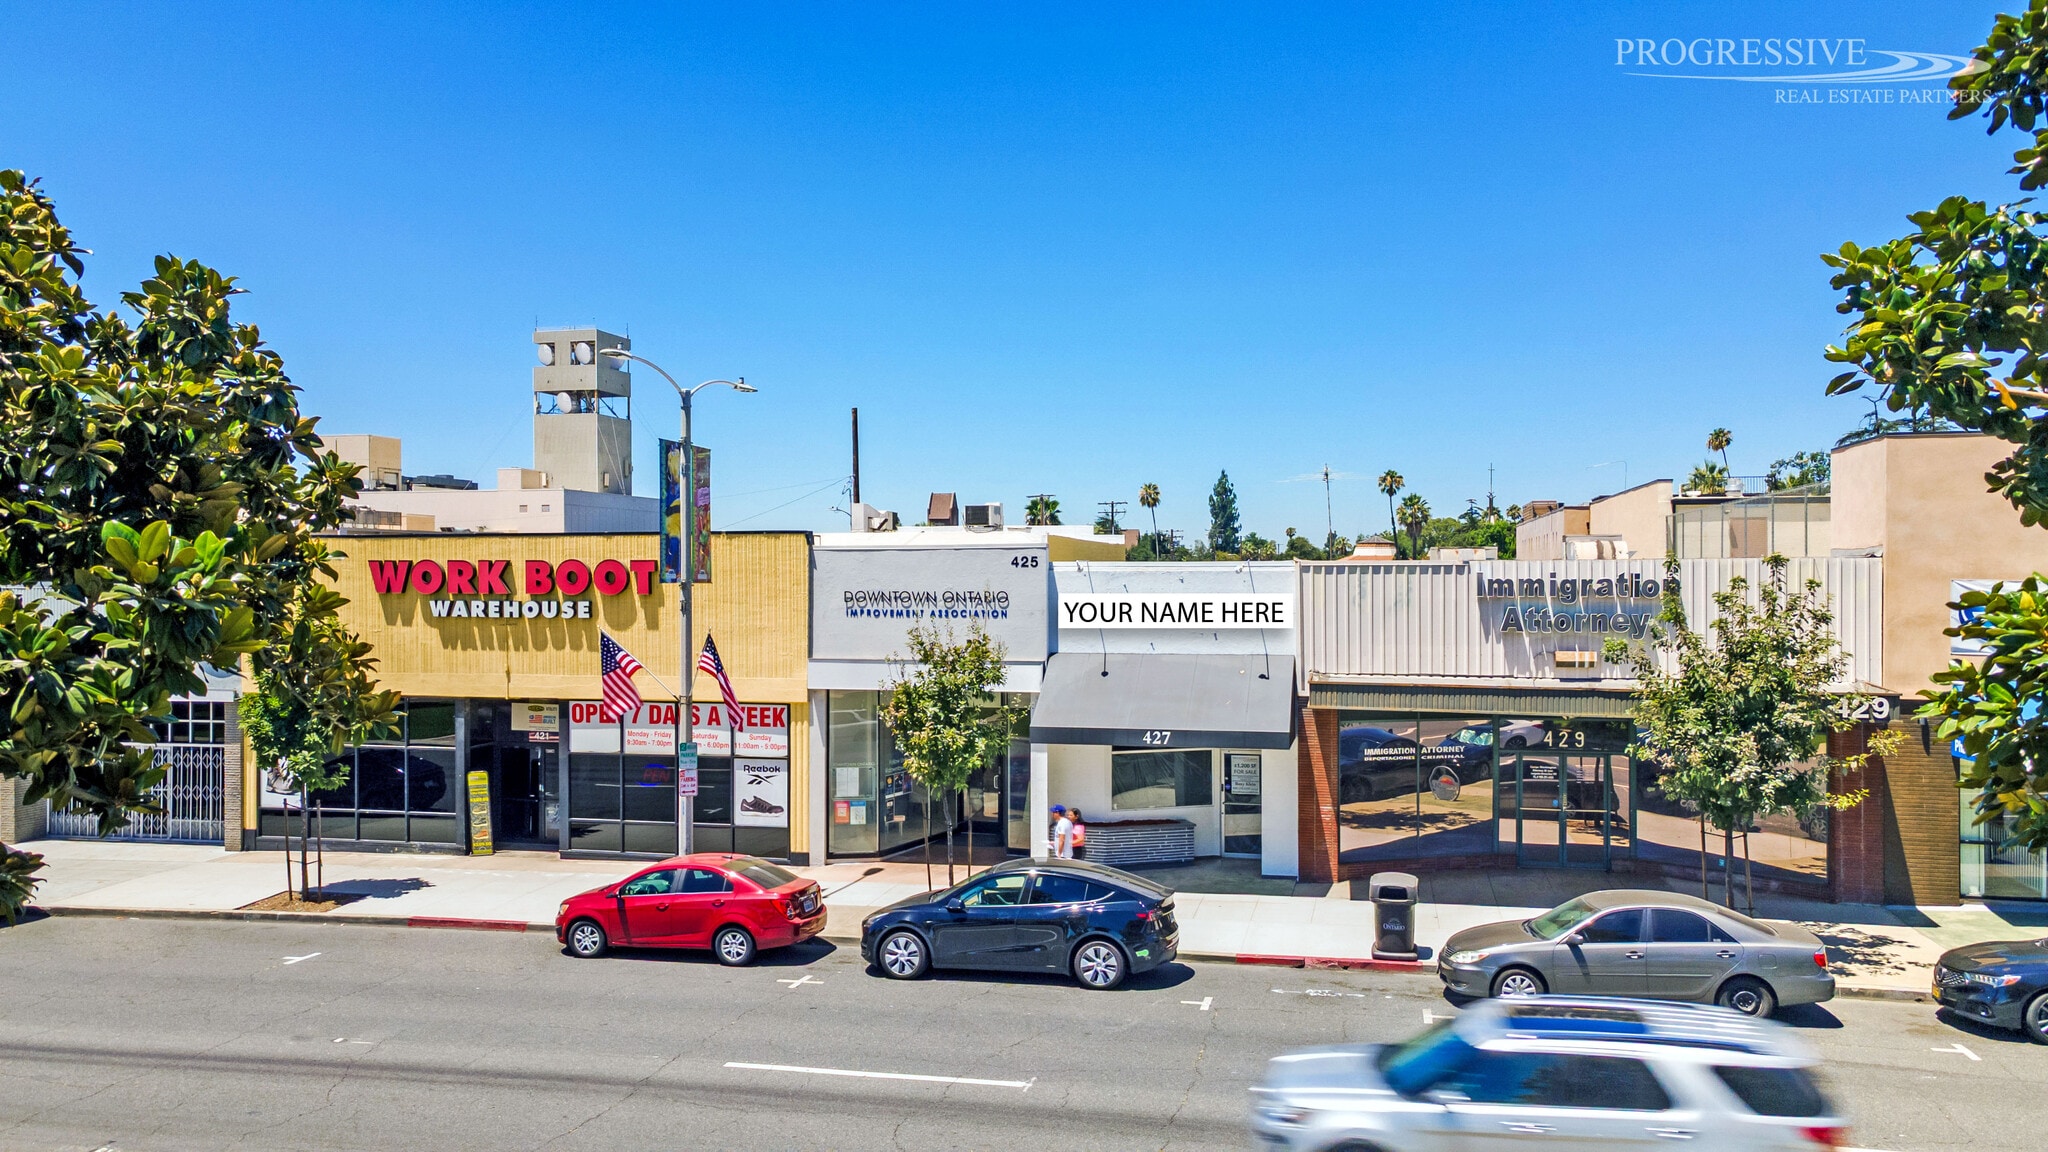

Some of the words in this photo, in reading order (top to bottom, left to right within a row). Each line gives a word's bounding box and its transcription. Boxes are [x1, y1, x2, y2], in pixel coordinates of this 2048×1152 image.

[1011, 556, 1039, 569] 425
[368, 559, 512, 595] WORK
[525, 558, 658, 596] BOOT
[844, 590, 937, 604] DOWNTOWN
[942, 590, 1009, 604] ONTARIO
[429, 600, 593, 619] WAREHOUSE
[846, 608, 925, 619] IMPROVEMENT
[930, 608, 1008, 620] ASSOCIATION
[1500, 606, 1651, 640] Attorney
[649, 704, 701, 726] DAS
[707, 705, 721, 726] A
[1834, 697, 1890, 719] 429
[534, 732, 549, 740] 421
[627, 730, 649, 738] Monday
[654, 730, 672, 738] Friday
[1142, 730, 1172, 745] 427
[1543, 730, 1584, 747] 429
[707, 741, 729, 749] 6:00pm
[1364, 747, 1415, 755] IMMIGRATION
[743, 764, 781, 773] Reebok
